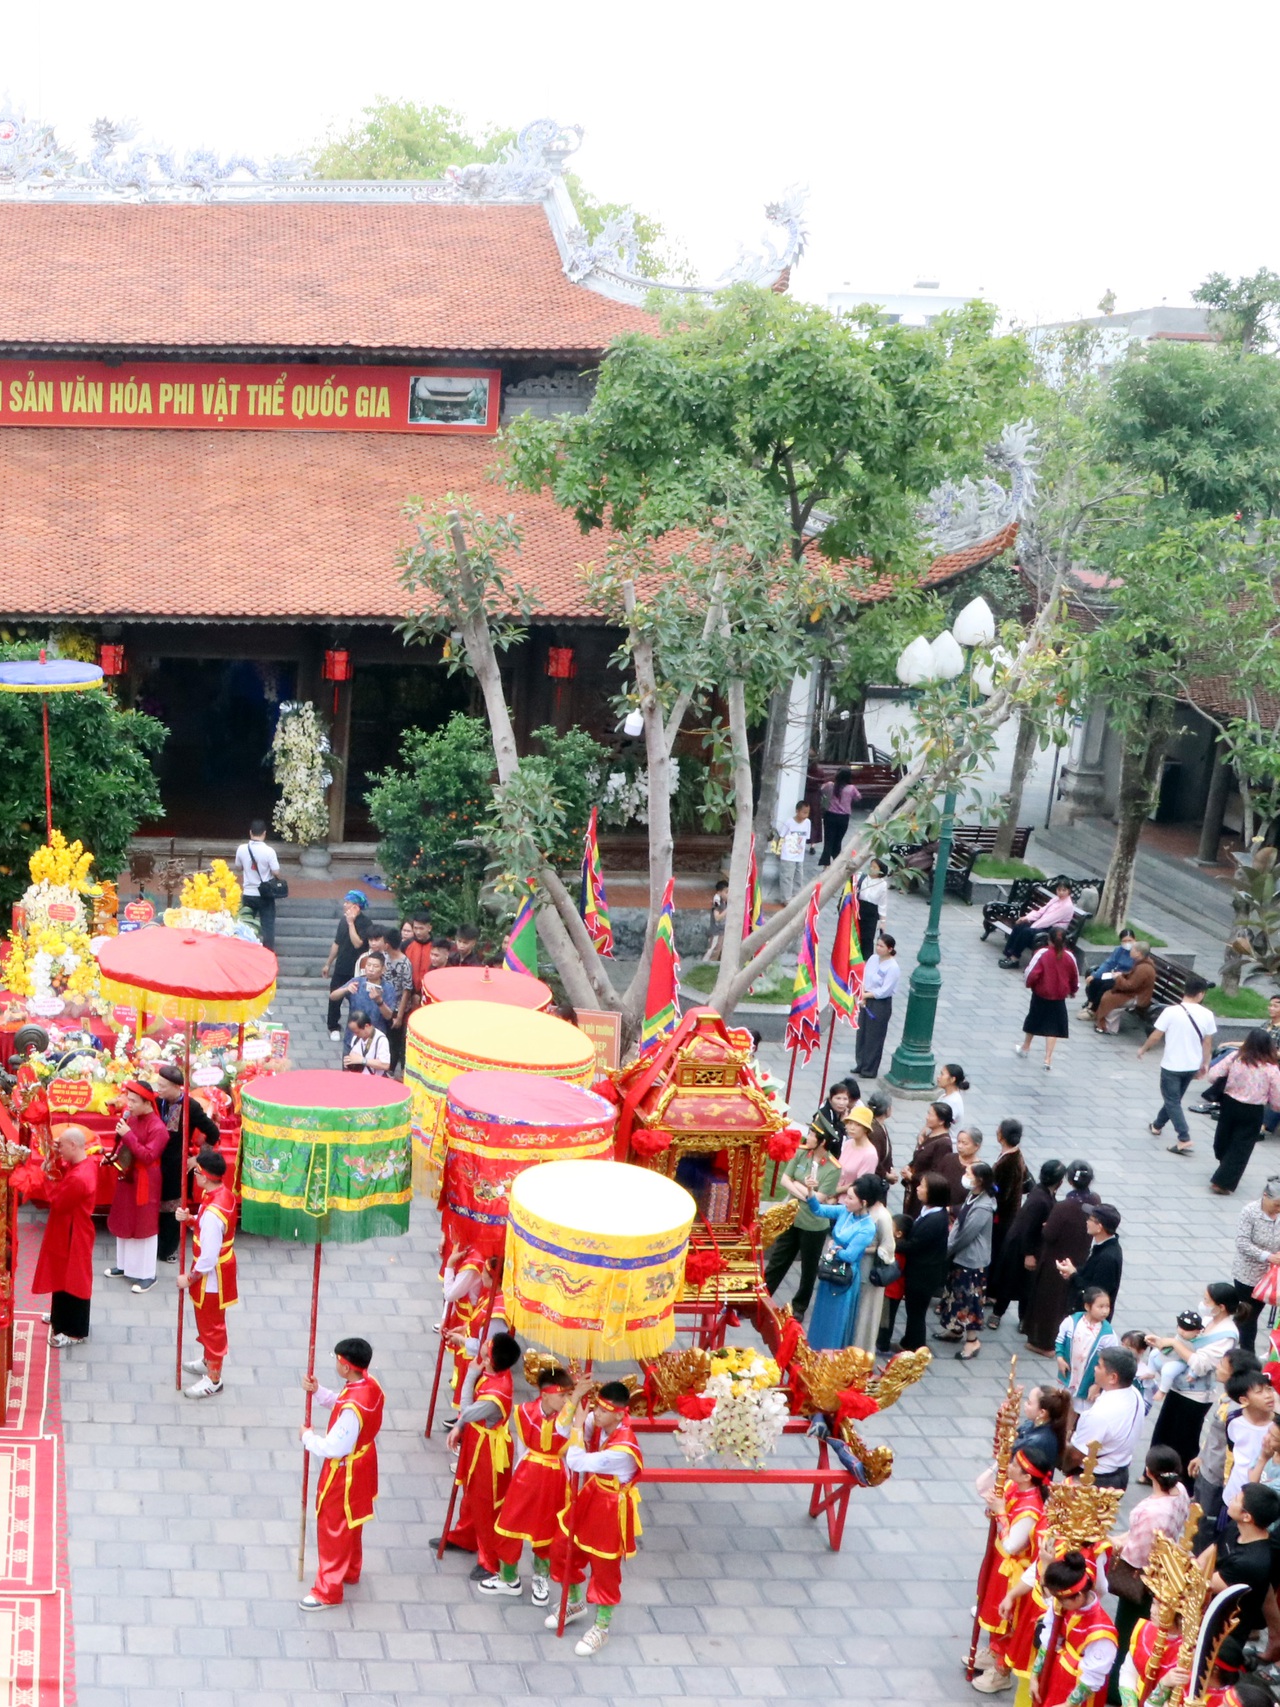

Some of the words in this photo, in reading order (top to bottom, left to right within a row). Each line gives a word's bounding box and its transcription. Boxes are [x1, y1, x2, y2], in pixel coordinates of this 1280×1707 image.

[8, 371, 53, 412] SẢN
[60, 374, 103, 413] VĂN
[109, 376, 152, 414] HÓA
[158, 383, 194, 415] PHI
[201, 377, 240, 422] VẬT
[246, 372, 285, 416] THỂ
[290, 374, 348, 418] QUỐC
[354, 385, 391, 418] GIA
